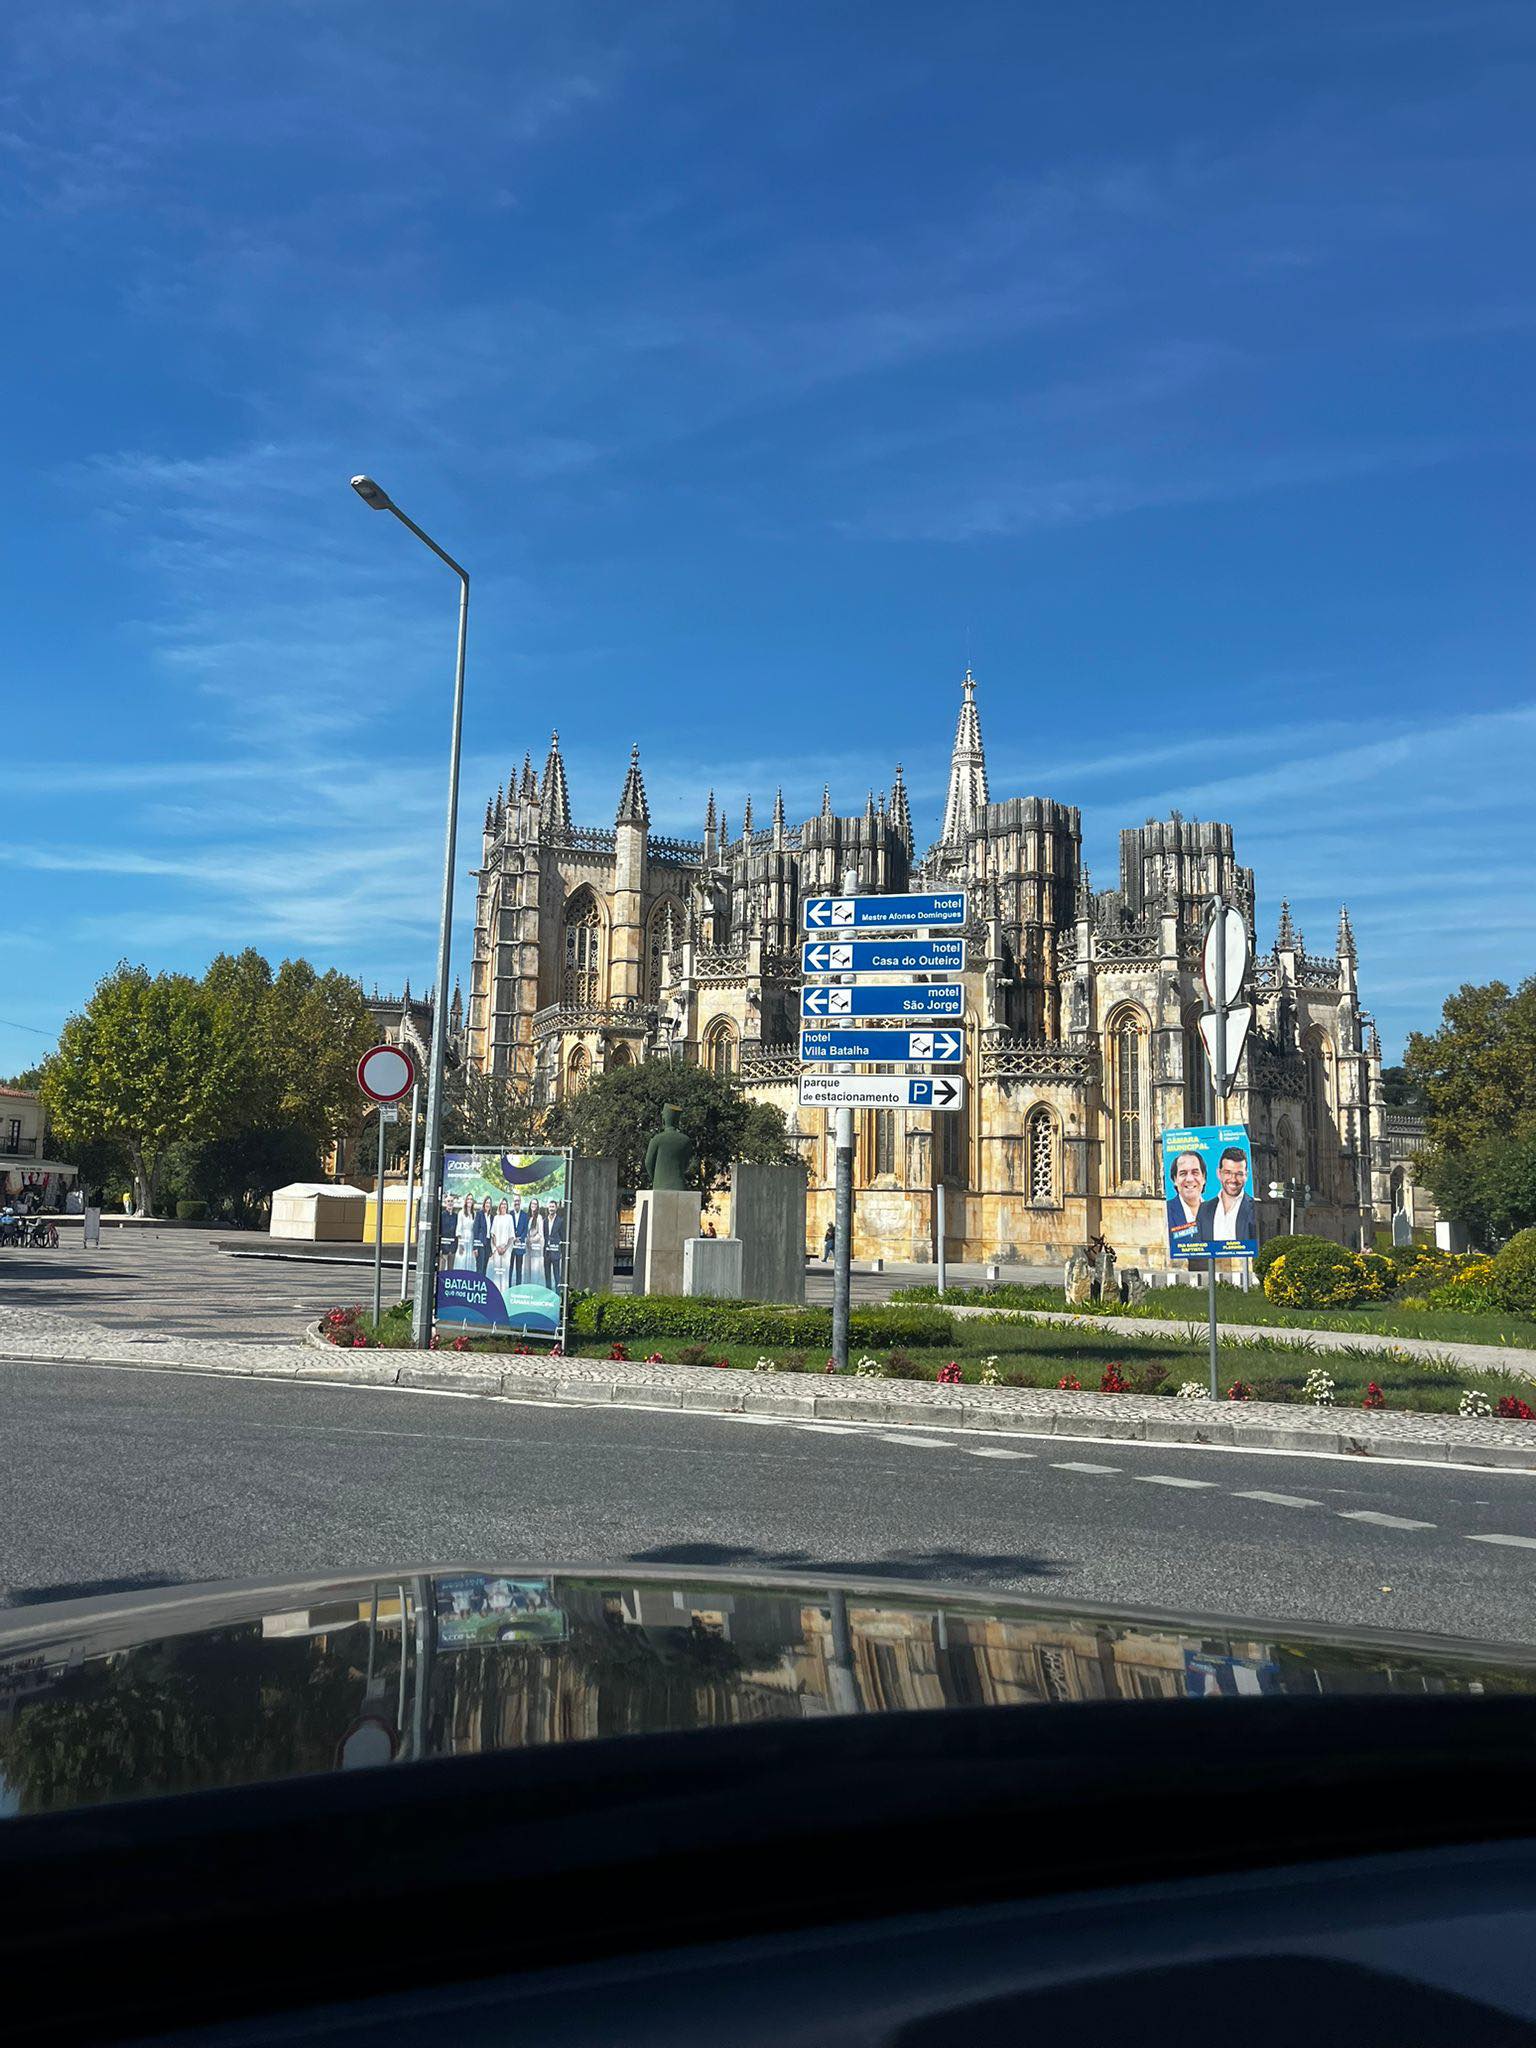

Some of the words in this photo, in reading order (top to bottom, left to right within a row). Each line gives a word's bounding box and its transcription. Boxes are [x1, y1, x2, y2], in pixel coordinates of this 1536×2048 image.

[934, 899, 962, 909] hotel
[861, 913, 887, 921] Mestre
[888, 912, 916, 920] Afonso
[918, 911, 962, 921] Domingues
[932, 943, 960, 953] hotel
[872, 956, 899, 966] Casa
[901, 956, 916, 965] do
[918, 955, 960, 965] Outeiro
[928, 987, 959, 997] motel
[903, 1000, 924, 1010] São
[927, 999, 959, 1011] Jorge
[805, 1032, 831, 1042] hotel
[804, 1046, 827, 1056] Villa
[830, 1046, 870, 1056] Batalha
[803, 1078, 840, 1089] parque
[913, 1083, 928, 1101] P
[803, 1093, 813, 1101] de
[815, 1092, 900, 1103] estacionamento
[444, 1278, 488, 1292] BATALHA
[455, 1290, 466, 1298] nos
